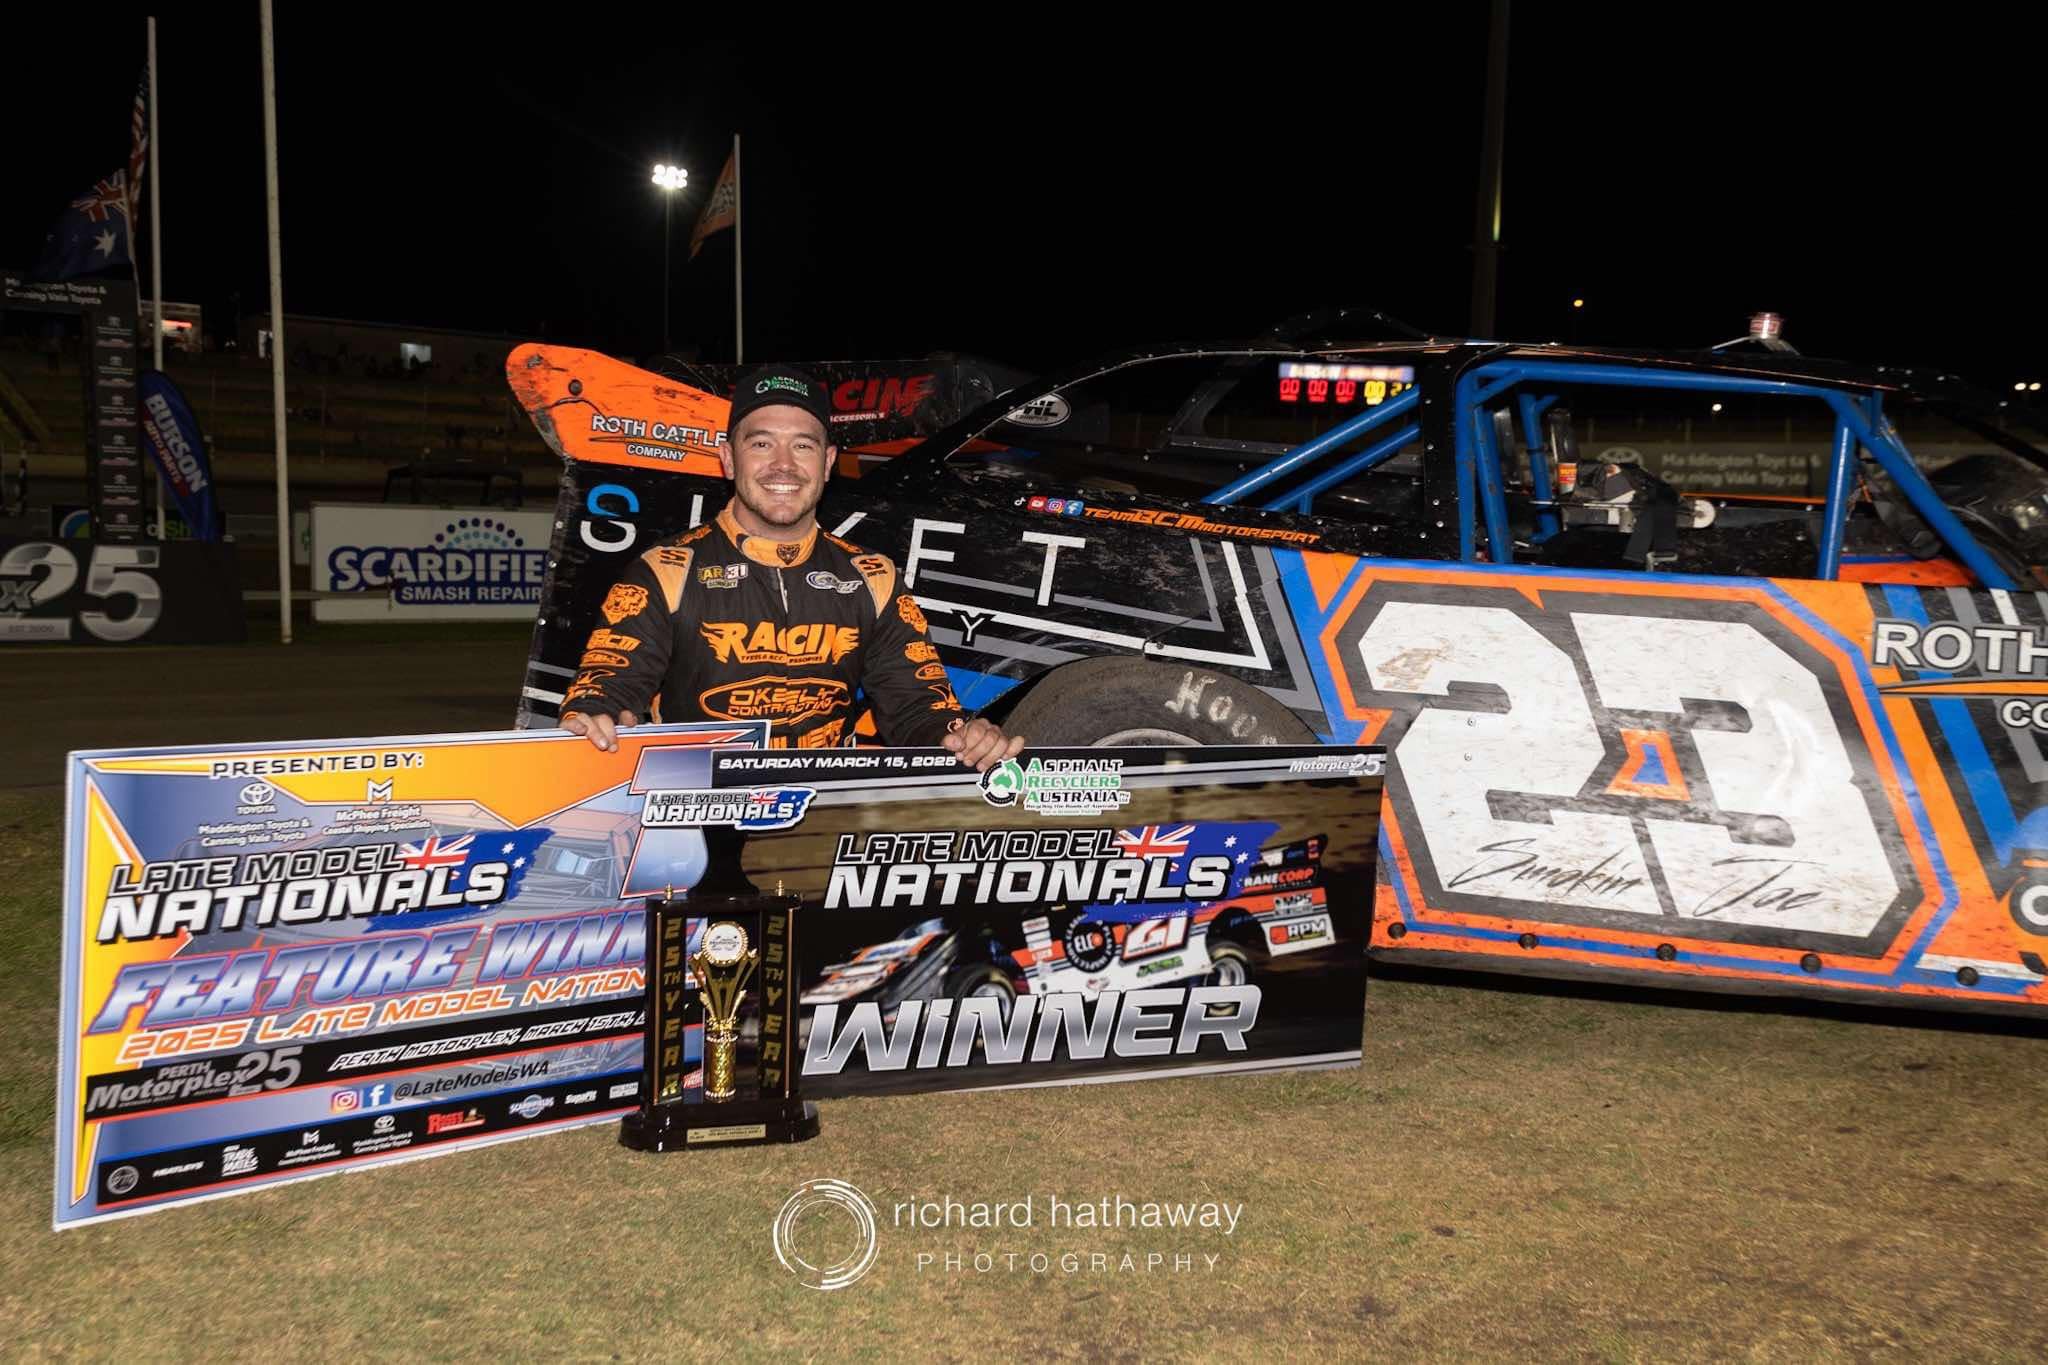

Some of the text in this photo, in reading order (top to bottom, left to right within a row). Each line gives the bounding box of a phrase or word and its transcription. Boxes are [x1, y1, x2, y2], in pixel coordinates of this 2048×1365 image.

[591, 414, 647, 438] ROTH
[144, 392, 208, 495] BURSON
[627, 444, 687, 461] COMPANY
[401, 586, 471, 601] SMASH
[212, 753, 424, 777] PRESENTED BY:
[719, 755, 957, 770] SATURDAY MARCH 15, 2025
[1028, 759, 1122, 773] ASPHALT
[1289, 754, 1383, 776] Motorplex 25
[1027, 775, 1121, 789] RECYCLERS
[651, 791, 754, 806] LATE MODEL
[1027, 789, 1119, 803] AUSTRALIA
[237, 804, 277, 815] TOYOTA
[336, 806, 422, 822] McPhee Freight
[647, 802, 794, 822] NATIONALS
[267, 819, 297, 831] Toyota
[202, 831, 306, 847] Canning Vale Toyota
[835, 828, 1122, 864] LATE MODEL
[108, 843, 407, 896] LATE MODEL
[824, 856, 1230, 909] NATIONALS
[97, 863, 508, 942] NATIONALS
[1287, 919, 1326, 936] RPM
[88, 925, 480, 1032] FEATURE
[117, 1017, 254, 1064] 2025
[256, 1000, 375, 1043] LATE
[377, 985, 513, 1027] MODEL
[521, 1018, 590, 1043] MARCH
[801, 985, 1261, 1076] WINNER
[158, 1060, 212, 1080] PERTH
[228, 1046, 303, 1097] 25
[395, 1060, 549, 1102] @LateModelsWA
[87, 1069, 250, 1112] Motorplex
